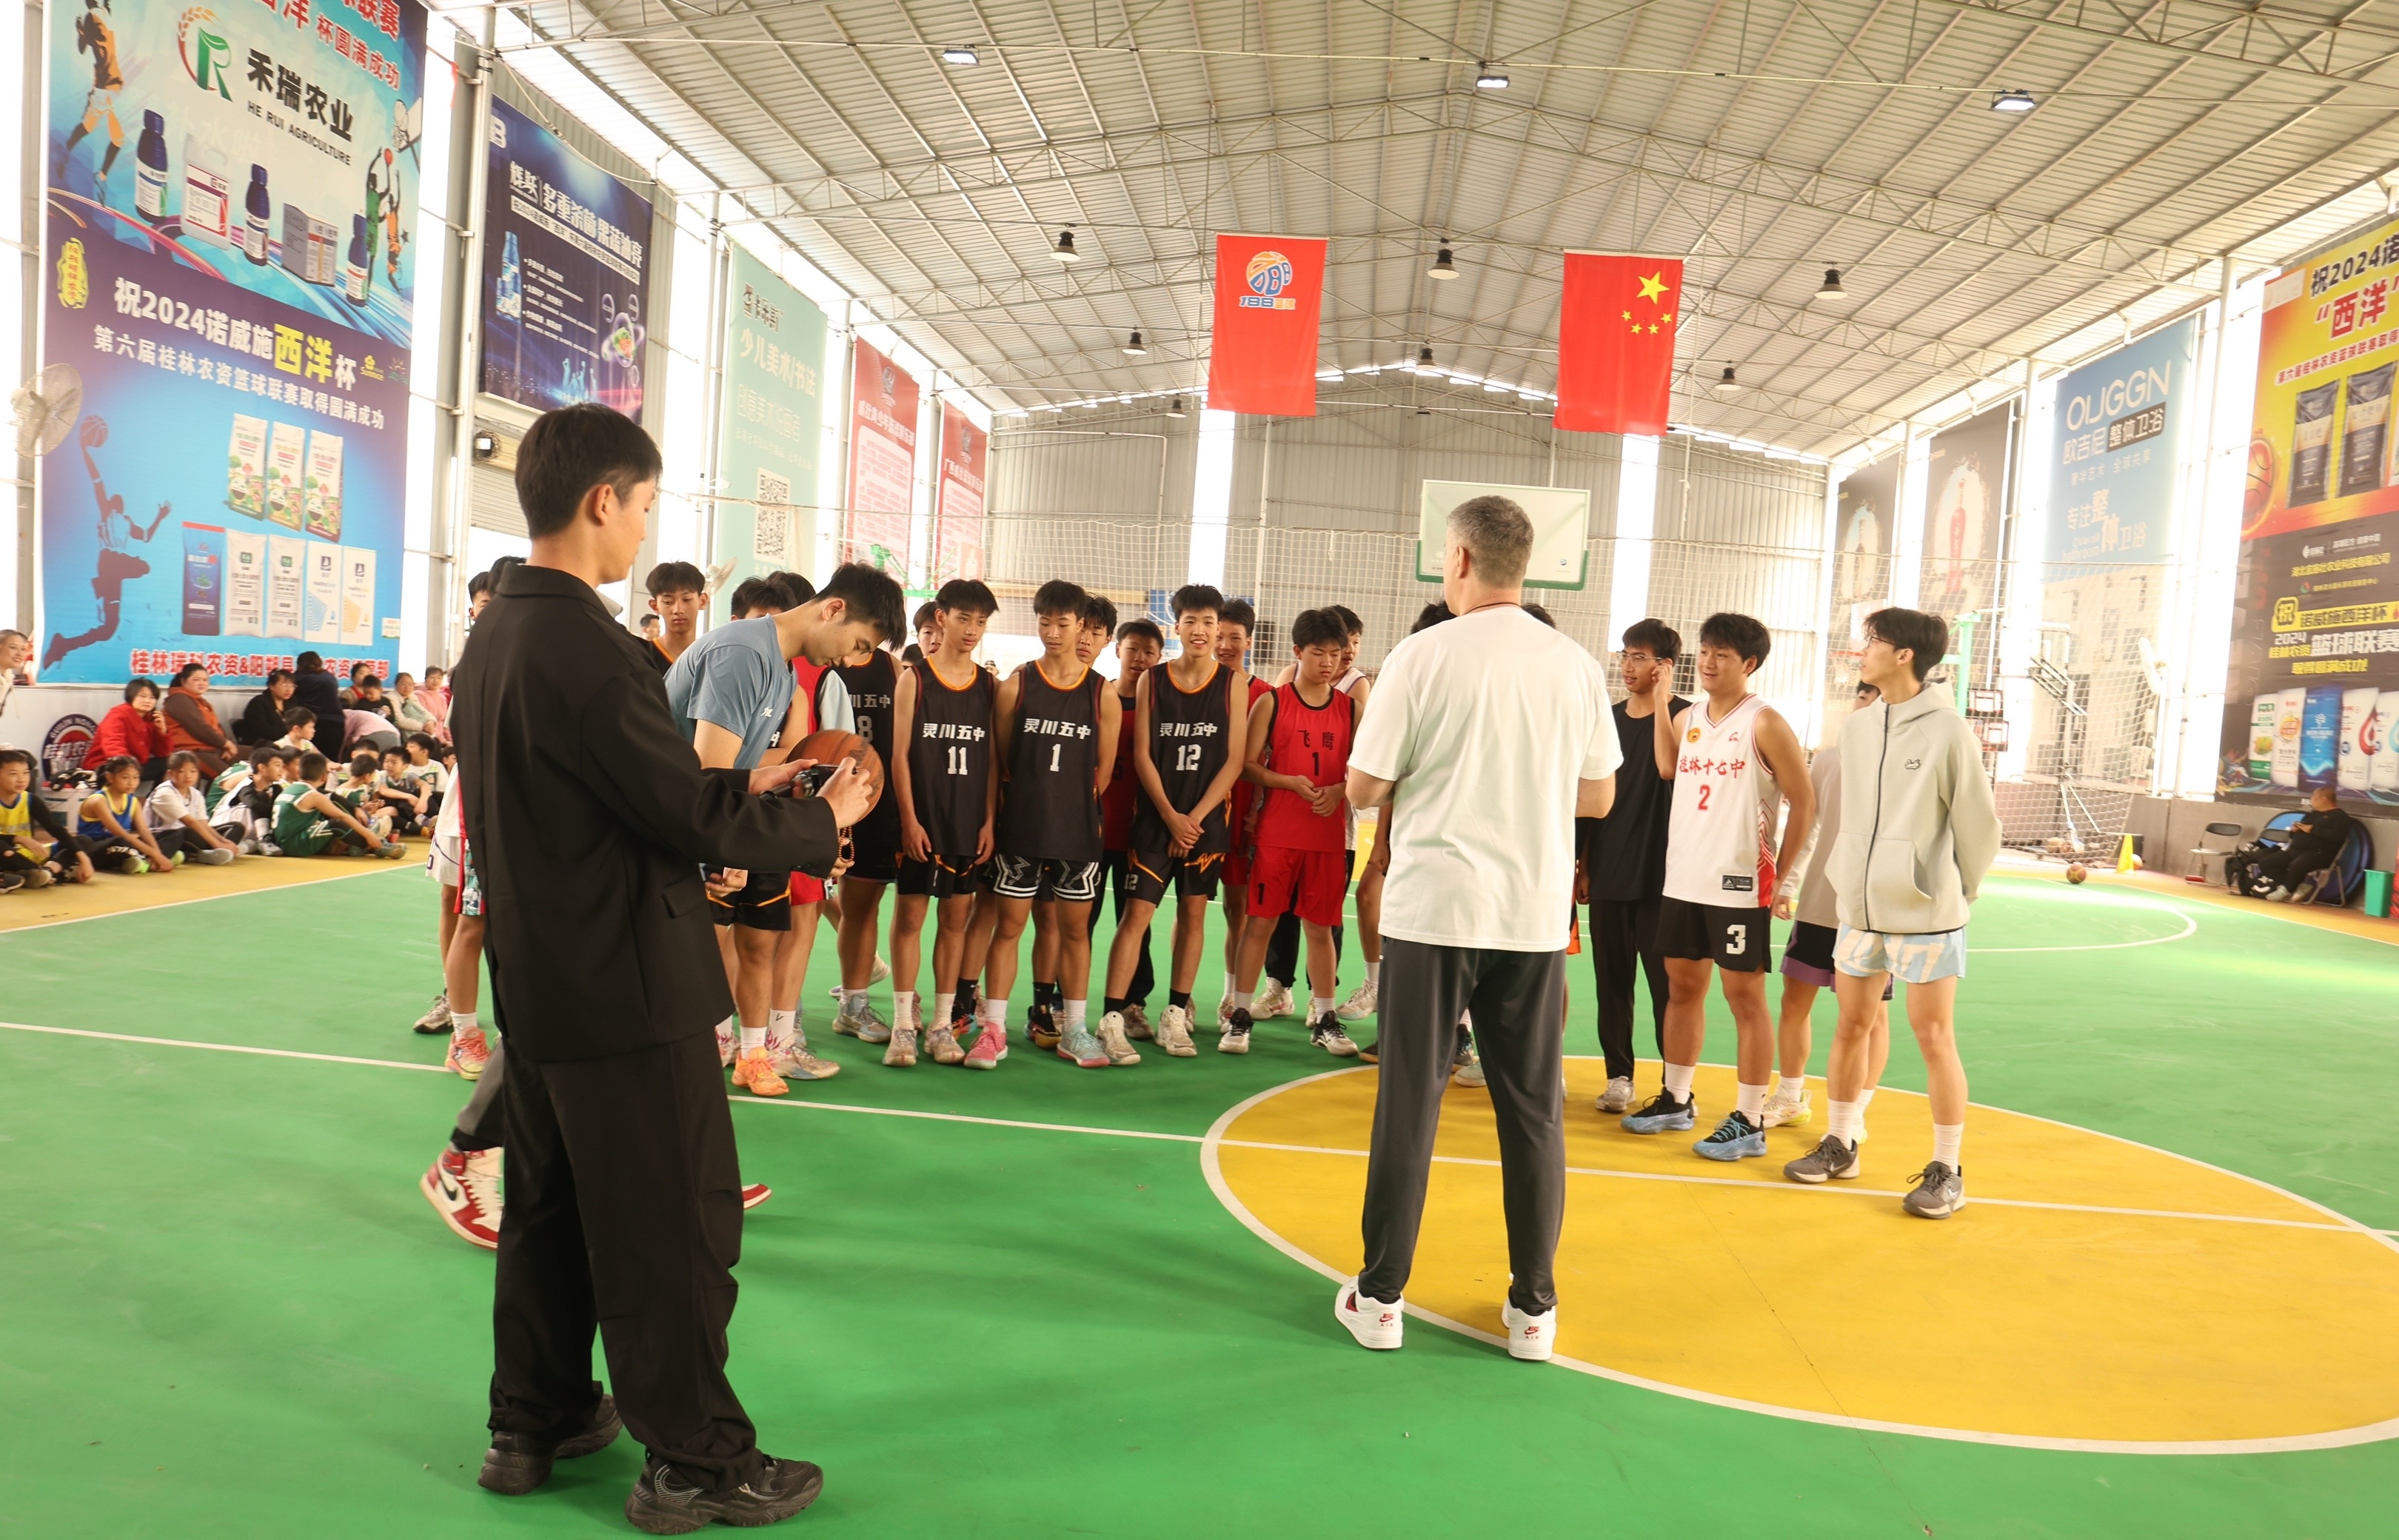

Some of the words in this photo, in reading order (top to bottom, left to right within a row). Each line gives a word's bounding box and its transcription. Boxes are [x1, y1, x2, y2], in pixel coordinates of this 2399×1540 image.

[342, 0, 401, 41] 联赛
[247, 47, 354, 142] 禾瑞农业
[248, 101, 262, 118] HE
[267, 110, 284, 130] RUI
[288, 124, 351, 166] AGRICULTURE
[543, 183, 596, 238] 多重杀菌
[114, 277, 358, 391] 祝2024诺威施西洋杯
[94, 324, 384, 429] 第六届桂林农资篮球联赛取得圆满成功
[740, 328, 815, 398] 少儿美术/书法
[2067, 360, 2171, 430] OUGGN
[2064, 427, 2107, 464] 欧吉尼
[2109, 408, 2164, 447] 整体卫浴
[2278, 602, 2295, 623] 祝
[2300, 605, 2387, 628] 诺威施西洋杯
[2275, 632, 2307, 645] 2024
[2311, 629, 2399, 657] 篮球联赛
[857, 715, 874, 743] 8
[923, 723, 986, 742] 灵川五中
[1023, 718, 1091, 740] 灵川五中
[1160, 722, 1218, 737] 灵川五中
[948, 746, 968, 775] 11
[1050, 743, 1062, 772] 1
[1176, 744, 1202, 771] 12
[1312, 751, 1319, 777] 1
[1697, 785, 1710, 810] 2
[1124, 874, 1139, 890] 12
[1257, 883, 1265, 905] 1
[1726, 924, 1746, 955] 3
